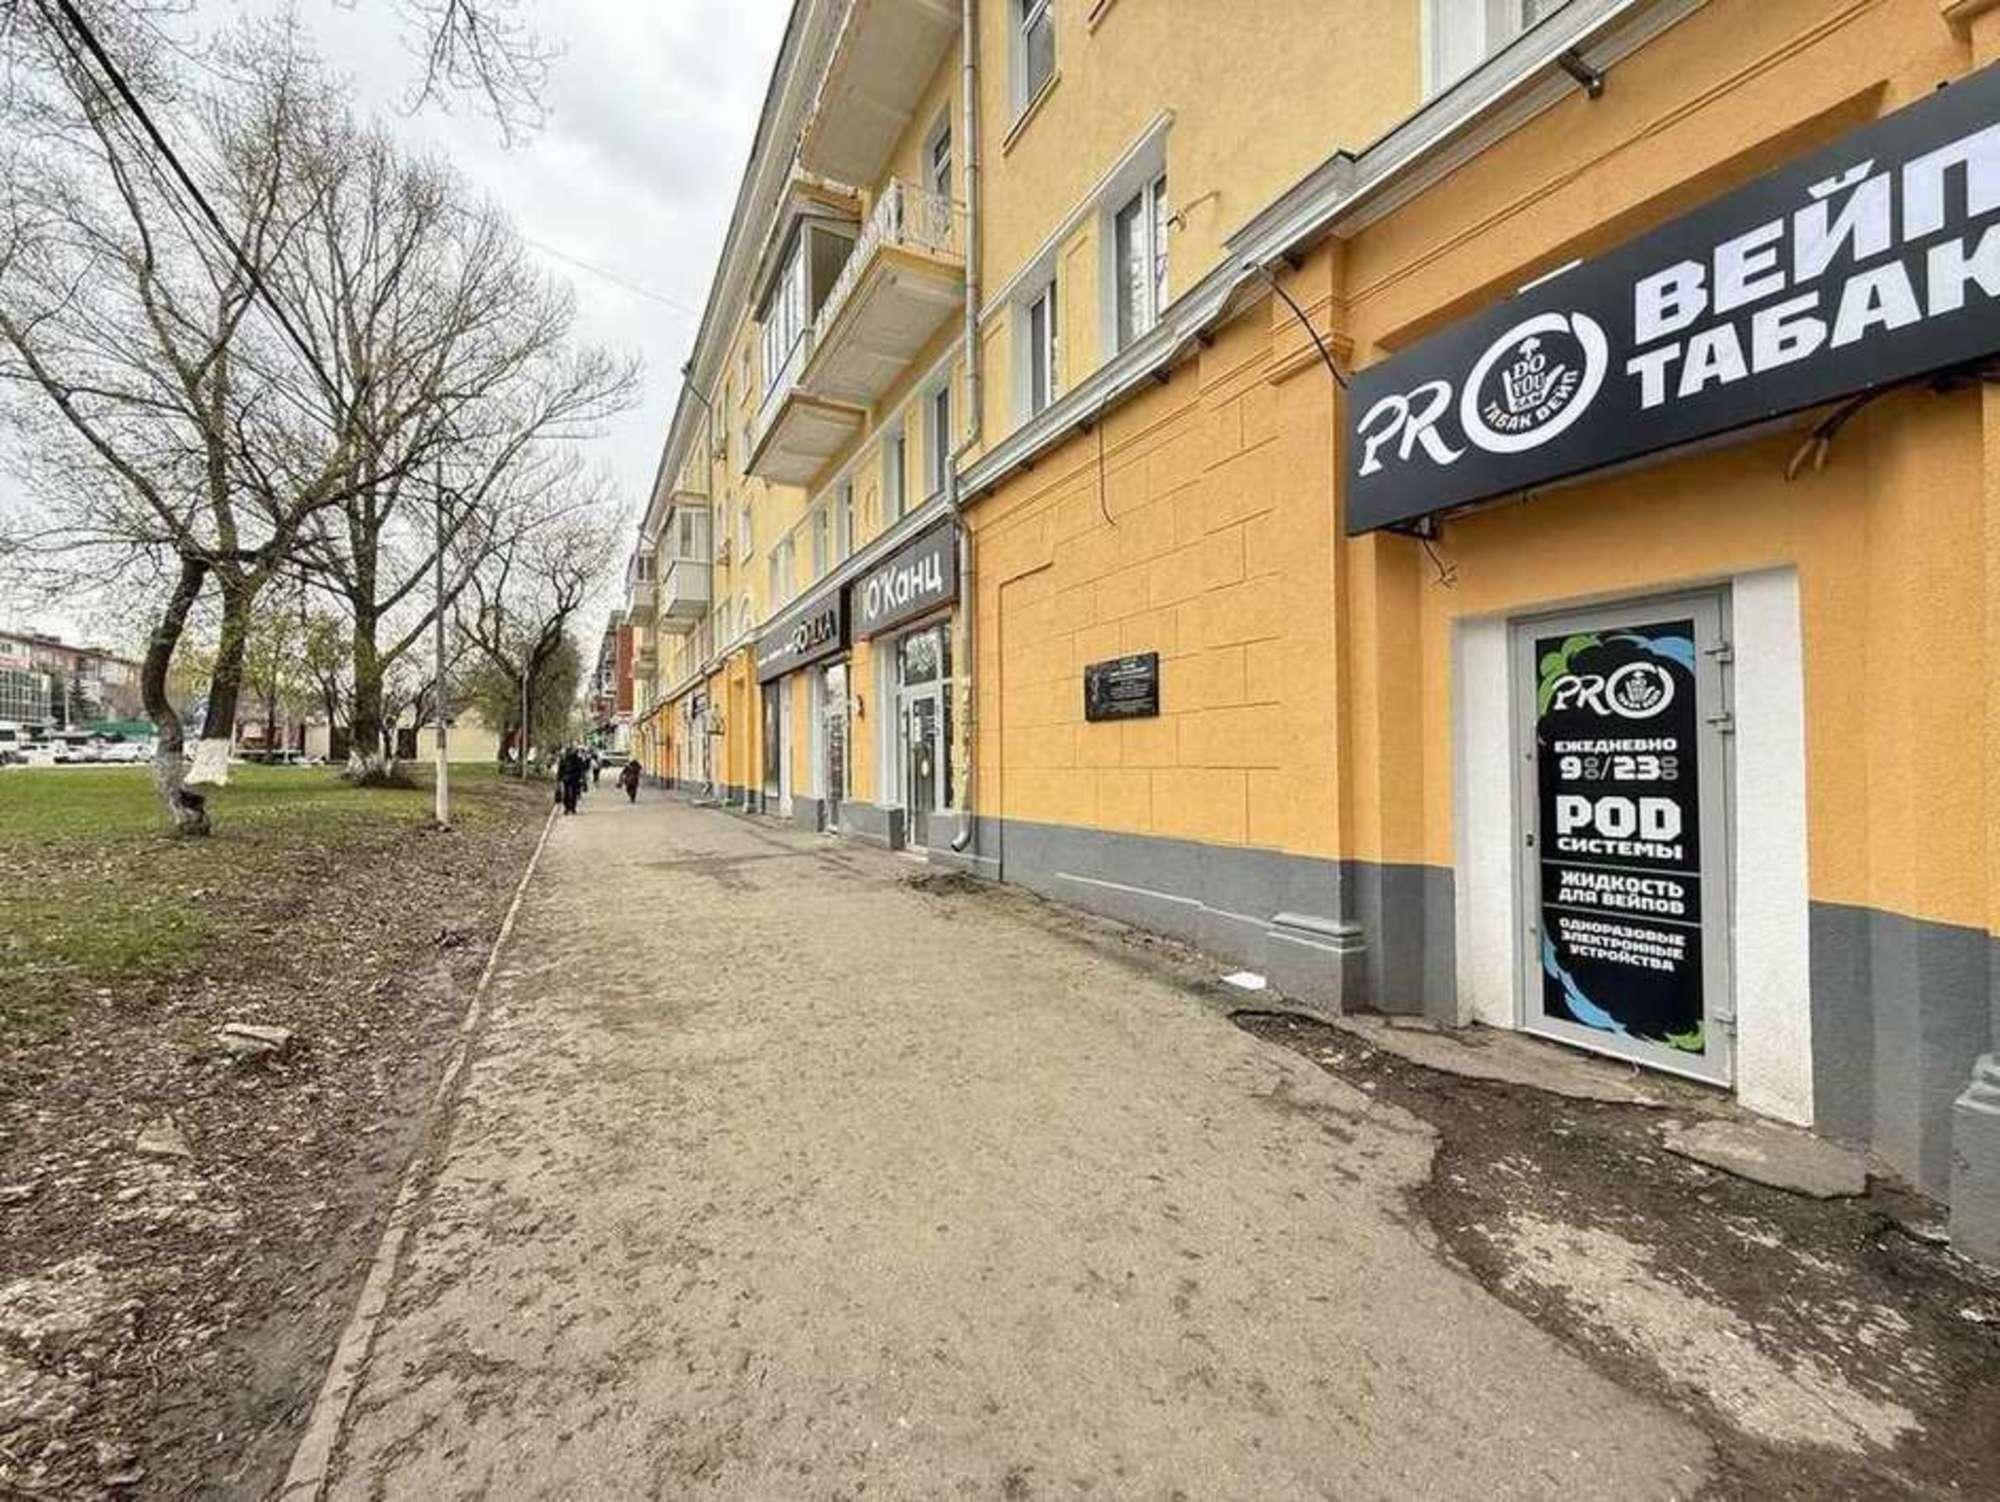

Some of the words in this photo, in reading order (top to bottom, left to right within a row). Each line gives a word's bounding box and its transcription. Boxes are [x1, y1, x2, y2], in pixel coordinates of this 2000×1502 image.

[1635, 123, 2000, 346] ВЕЙП
[1626, 222, 2000, 411] ТАБАК
[1512, 353, 1546, 380] DO
[1358, 312, 1609, 477] PRO
[1552, 661, 1675, 719] PRO
[1554, 737, 1678, 754] ЕЖЕДНЕВНО
[1555, 794, 1683, 842] POD
[1556, 836, 1684, 861] СИСТЕМЫ
[1560, 869, 1685, 899] ЖИДКОСТЬ
[1558, 887, 1598, 904] ДЛЯ
[1601, 892, 1685, 915] ВЕЙПОВ
[1558, 917, 1686, 947] ОДНОРАЗОВЫЕ
[1560, 929, 1685, 961] ЭЛЕКТРОННЫЕ
[1568, 943, 1676, 973] УСТРОЙСТВА
